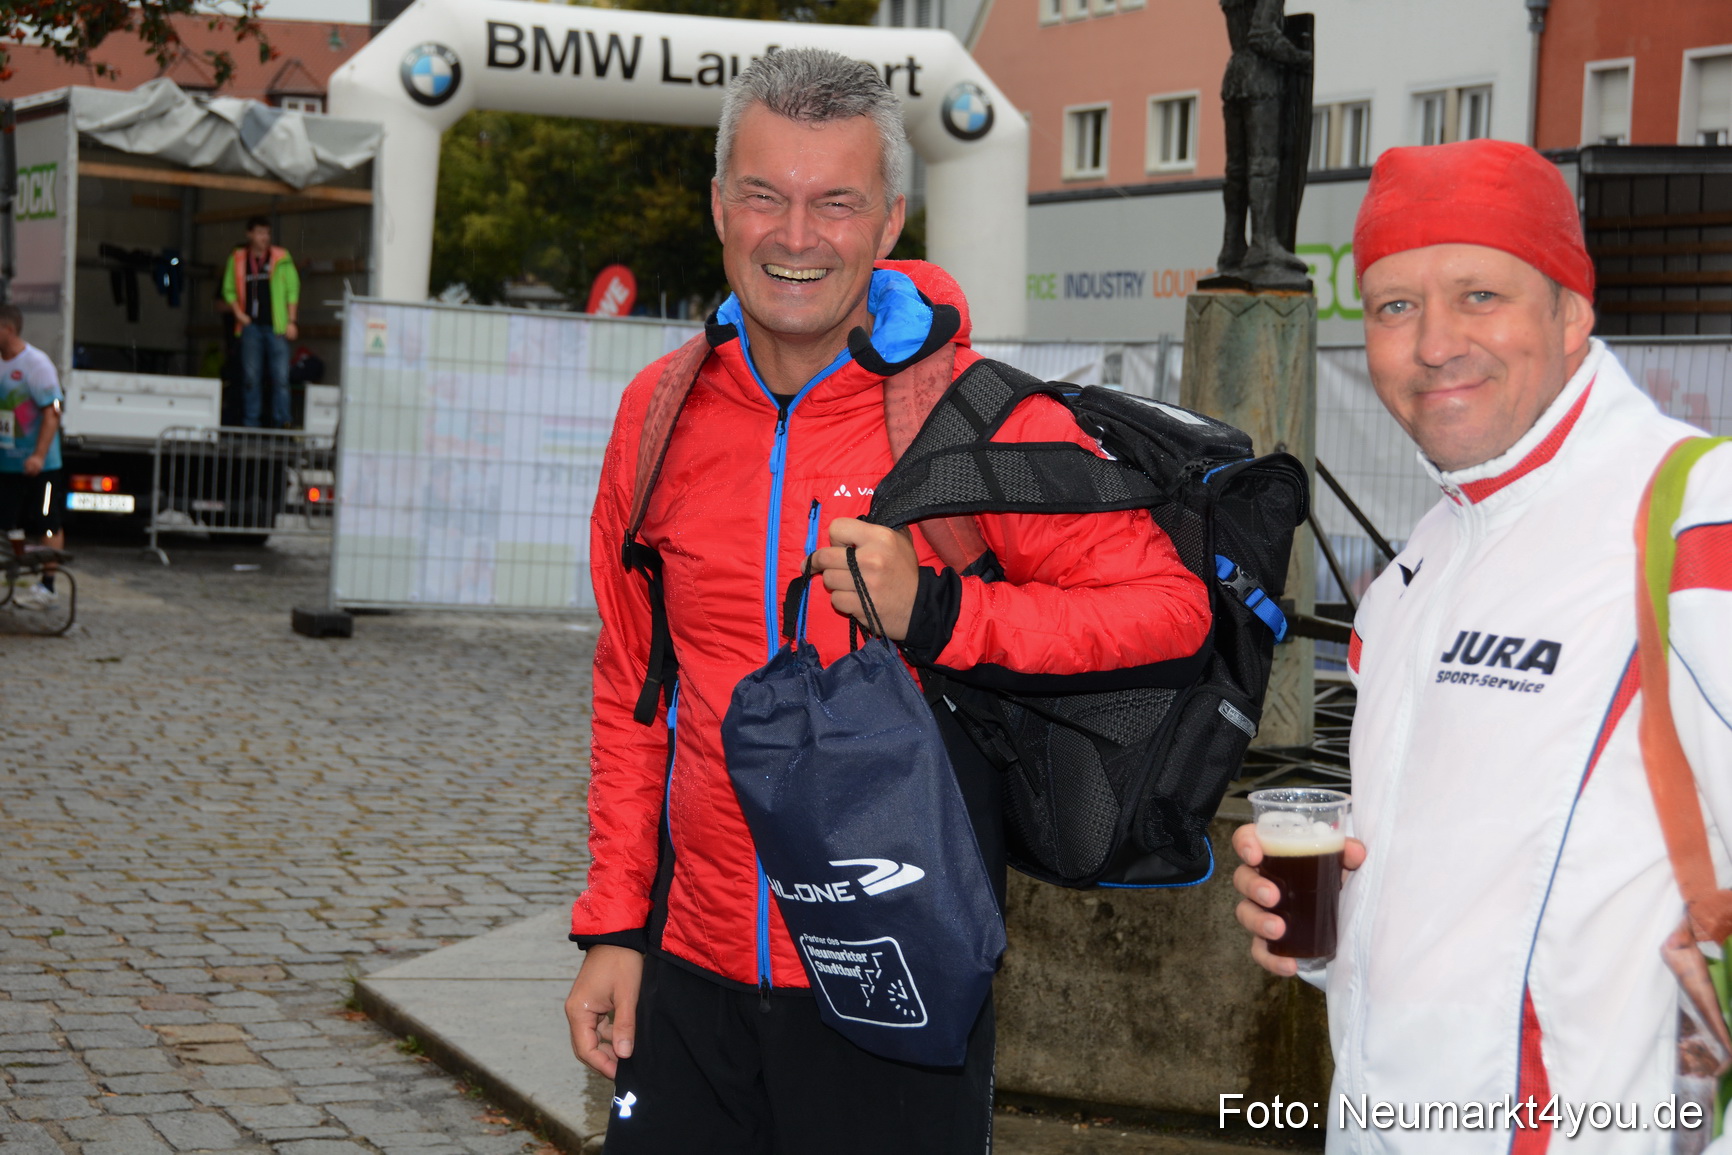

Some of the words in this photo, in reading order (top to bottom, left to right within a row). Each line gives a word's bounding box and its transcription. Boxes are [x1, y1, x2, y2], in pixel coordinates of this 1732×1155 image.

[485, 19, 643, 81] BMW
[1064, 270, 1147, 299] INDUSTRY
[857, 487, 875, 496] VA
[1440, 630, 1562, 675] JURA
[803, 933, 826, 945] Partner
[827, 937, 840, 946] des
[807, 945, 867, 963] Neumarkter
[814, 960, 863, 980] Stadtlauf
